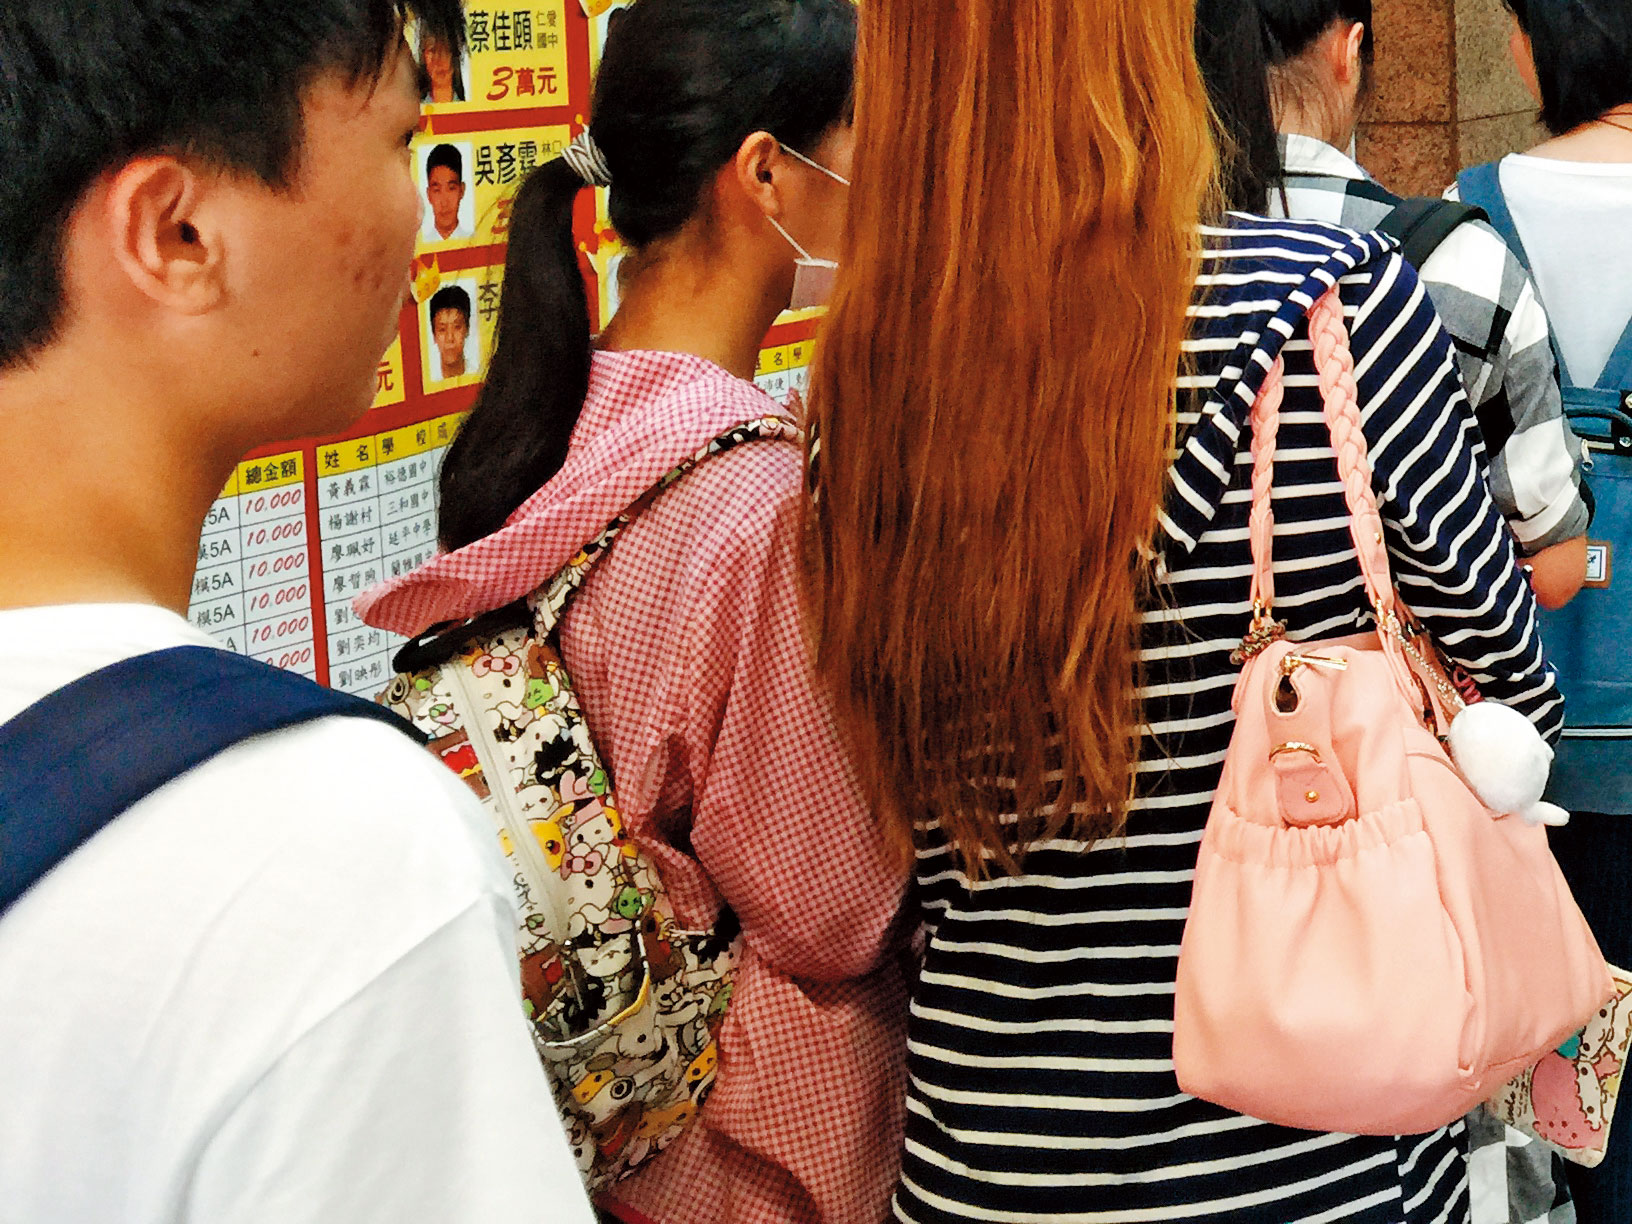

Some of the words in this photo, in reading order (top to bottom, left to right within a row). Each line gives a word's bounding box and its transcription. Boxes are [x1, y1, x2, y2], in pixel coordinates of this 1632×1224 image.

[486, 65, 558, 102] 3萬元
[245, 457, 298, 486] 總金額
[201, 505, 231, 528] 5A
